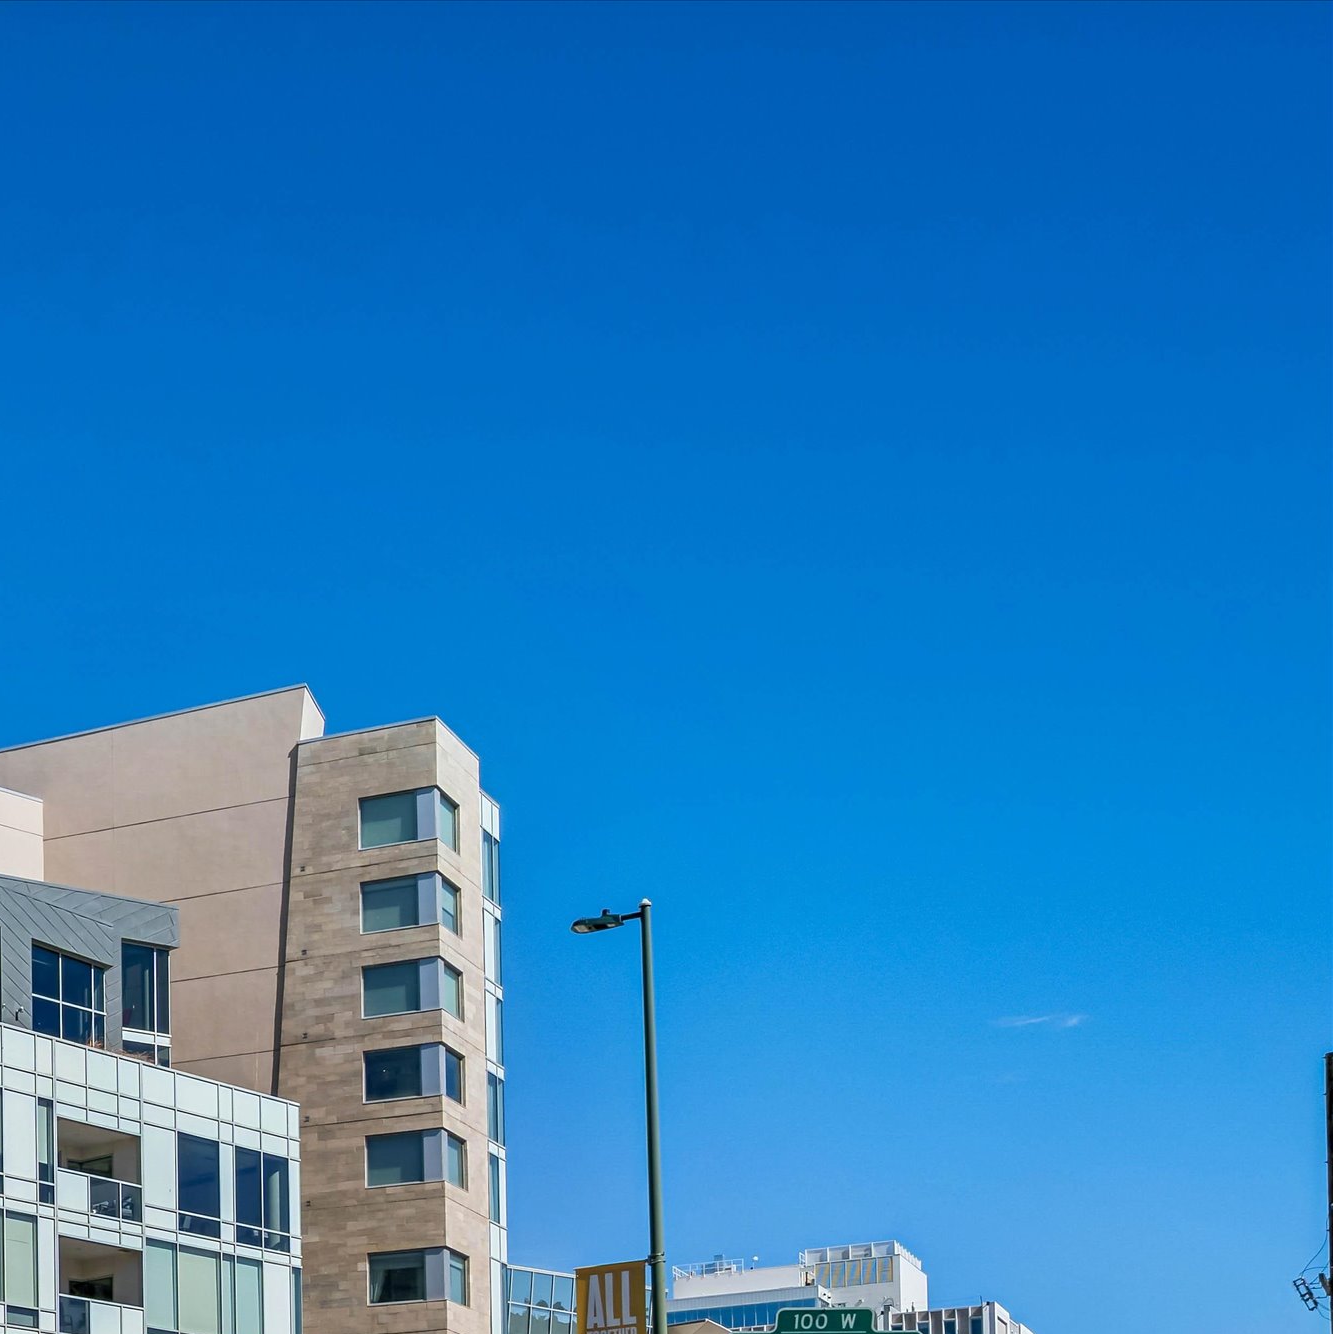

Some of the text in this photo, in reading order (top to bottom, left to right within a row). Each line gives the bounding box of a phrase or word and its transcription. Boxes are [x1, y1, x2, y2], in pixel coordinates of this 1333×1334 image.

[587, 1271, 637, 1329] ALL
[794, 1313, 856, 1330] 100 W
